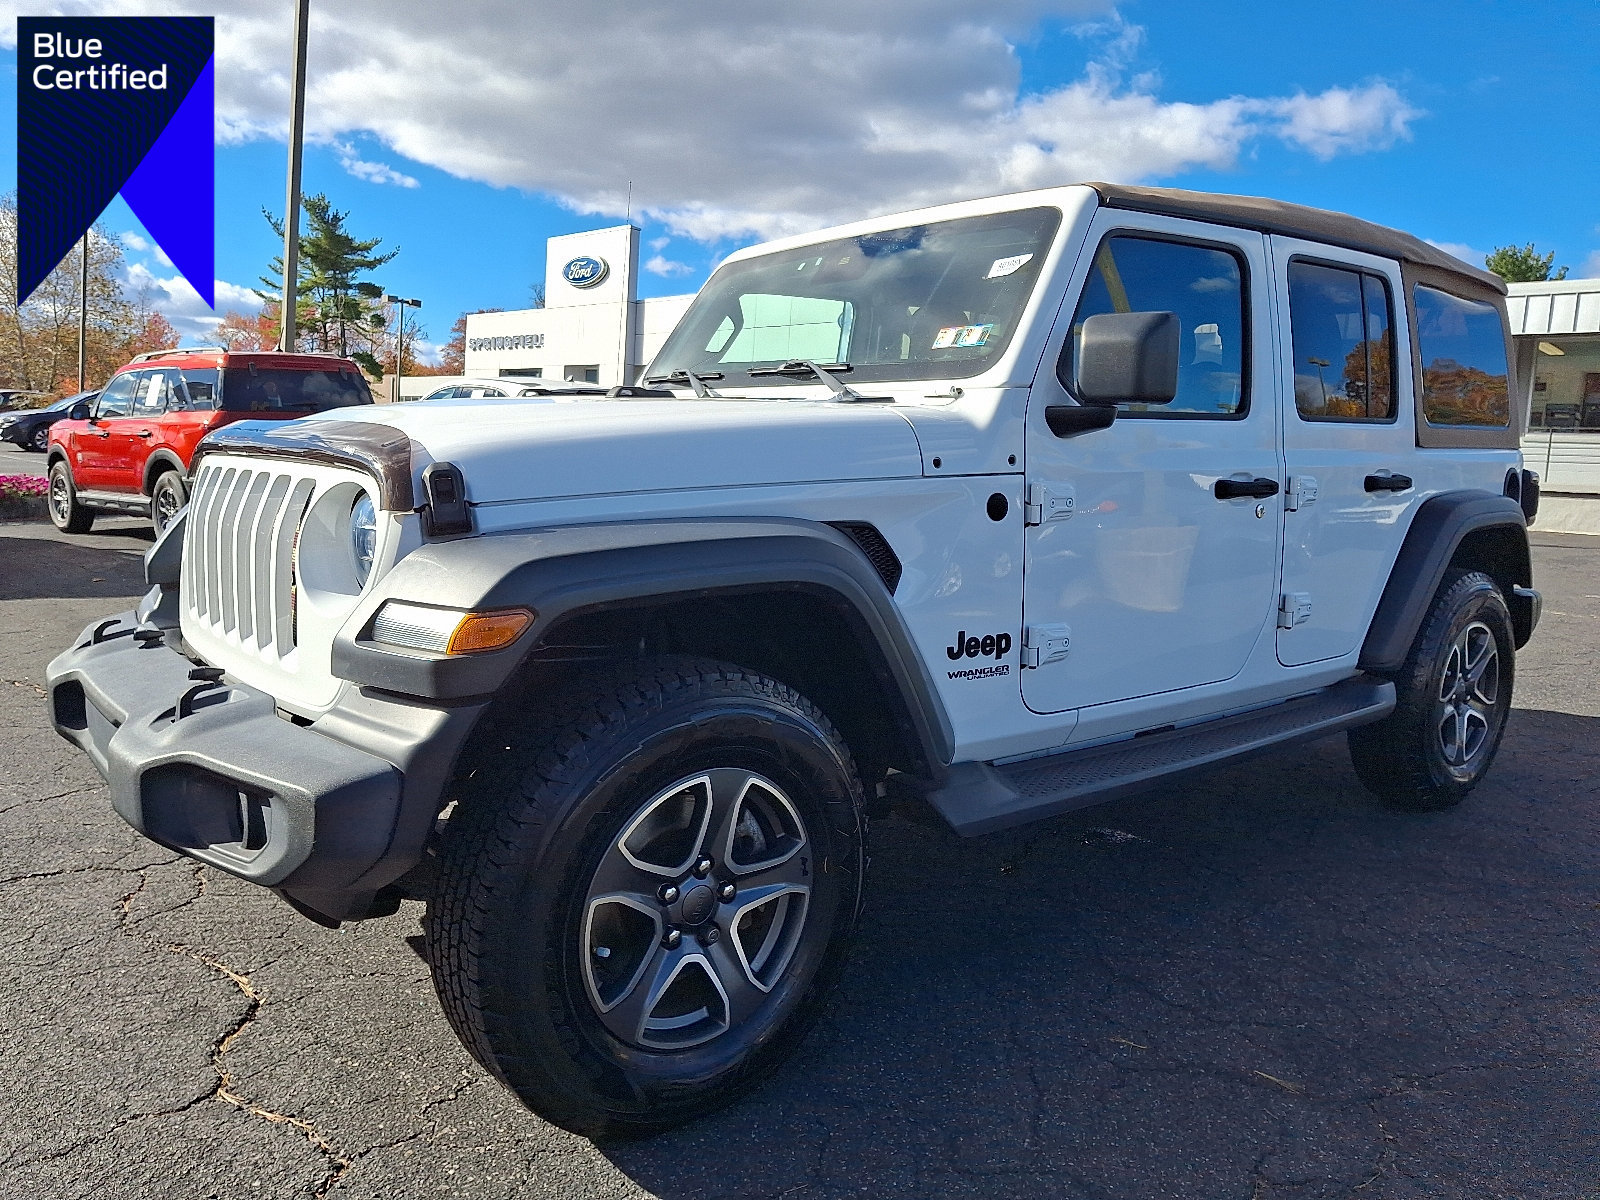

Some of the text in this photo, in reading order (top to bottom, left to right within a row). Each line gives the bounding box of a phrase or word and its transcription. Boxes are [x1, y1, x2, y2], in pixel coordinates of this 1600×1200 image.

[568, 260, 594, 280] Ford
[946, 630, 1012, 661] Jeep
[947, 664, 1010, 680] WRANGLER
[966, 671, 1010, 681] UNLIMITED
